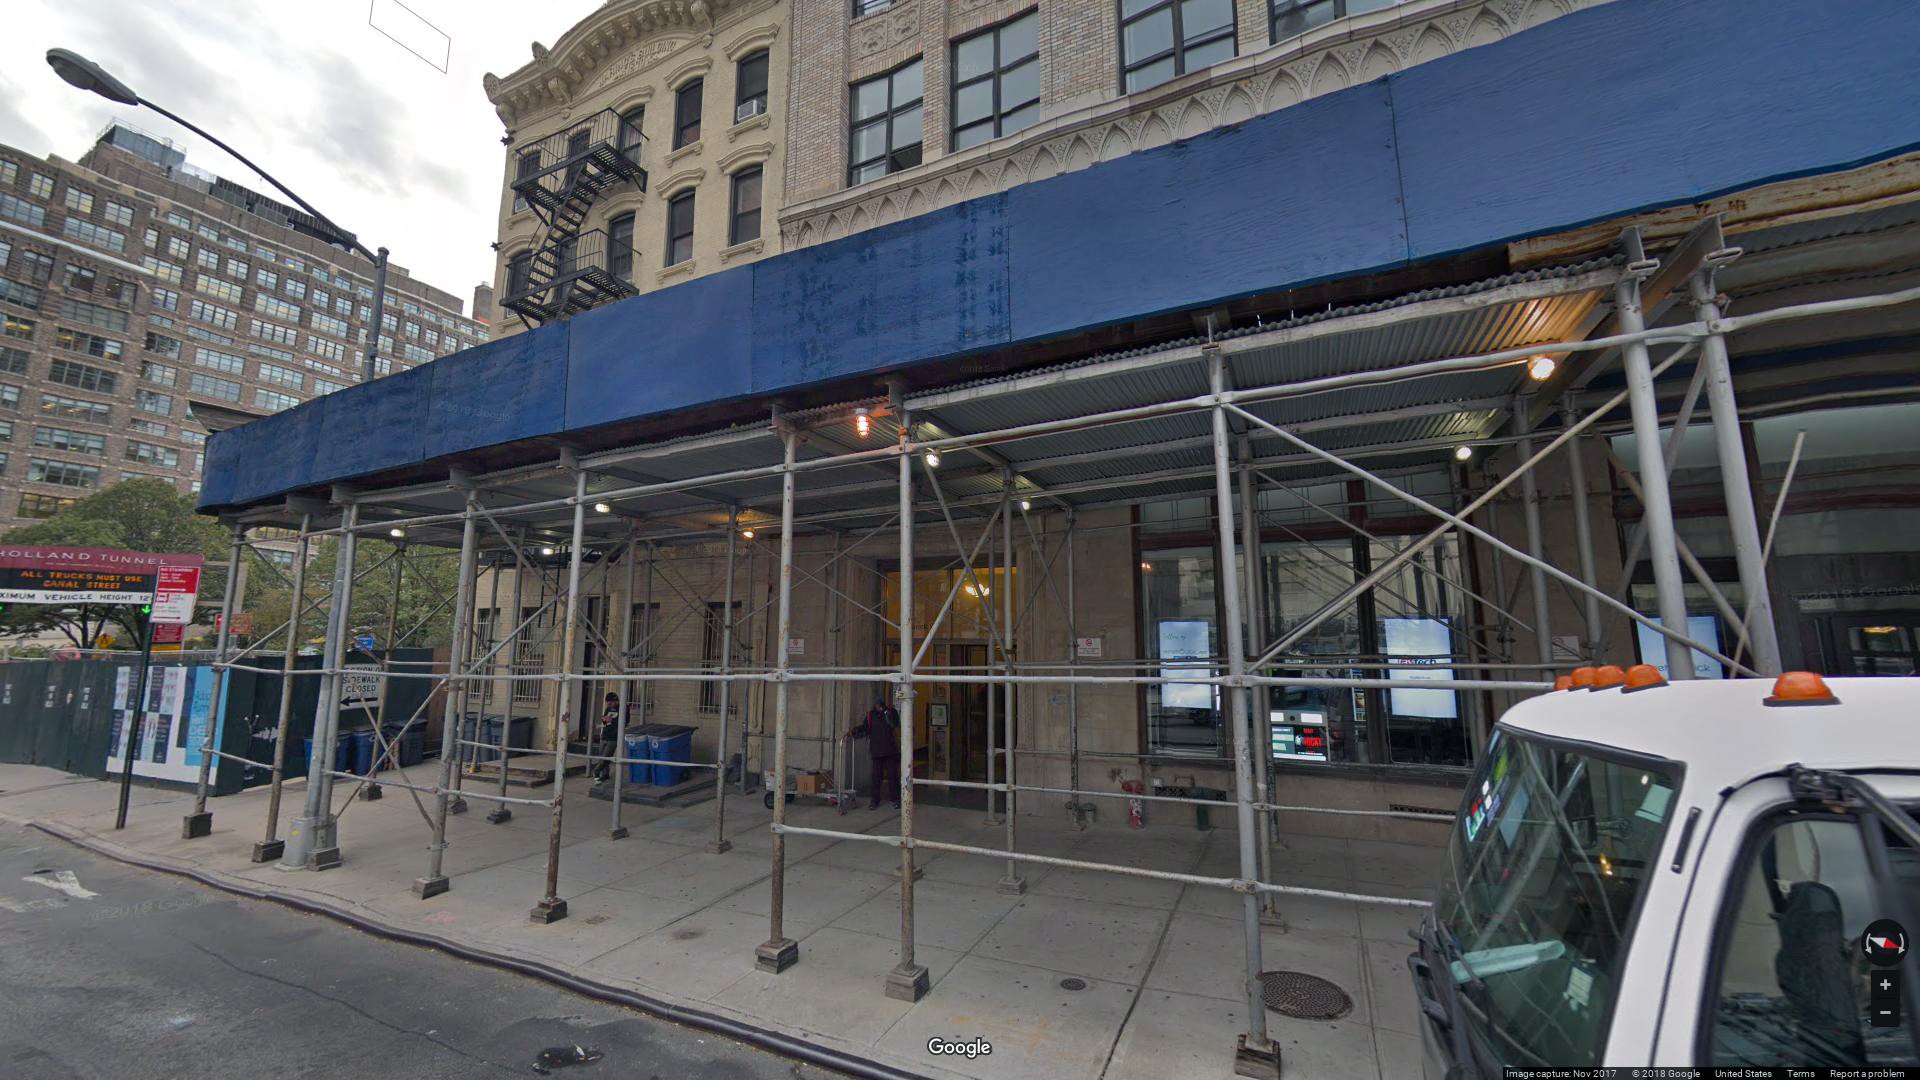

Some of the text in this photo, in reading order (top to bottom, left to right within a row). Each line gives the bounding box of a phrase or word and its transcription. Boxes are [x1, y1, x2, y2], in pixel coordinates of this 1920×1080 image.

[101, 554, 168, 564] TUNNEL
[21, 570, 43, 578] ALL
[48, 571, 93, 580] TRUCKS
[42, 580, 121, 589] CANAL STREET
[44, 593, 93, 601] VEHICLE
[346, 684, 376, 693] CLOSED
